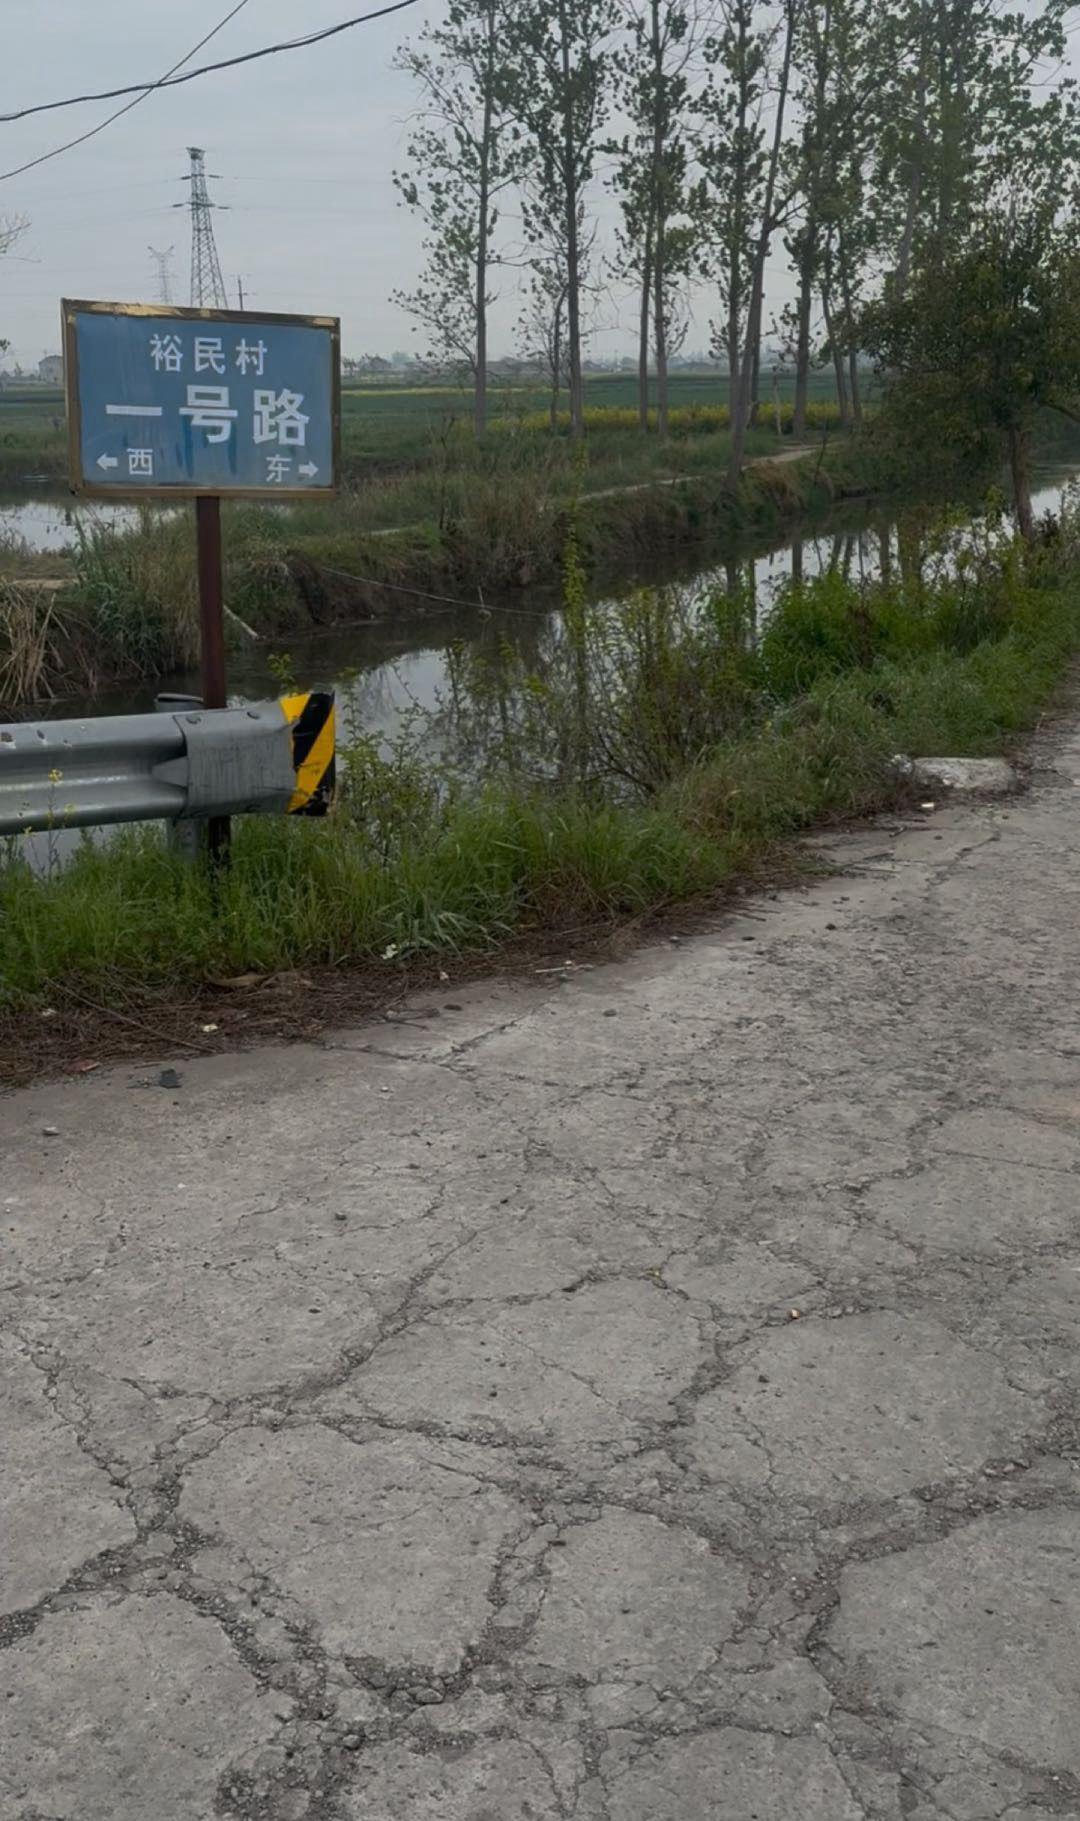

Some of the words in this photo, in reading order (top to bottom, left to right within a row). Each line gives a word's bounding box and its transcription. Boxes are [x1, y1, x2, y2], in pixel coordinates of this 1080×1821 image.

[150, 334, 267, 375] 裕民村
[106, 385, 309, 446] 一号路
[127, 448, 153, 475] 西
[265, 454, 292, 482] 东
